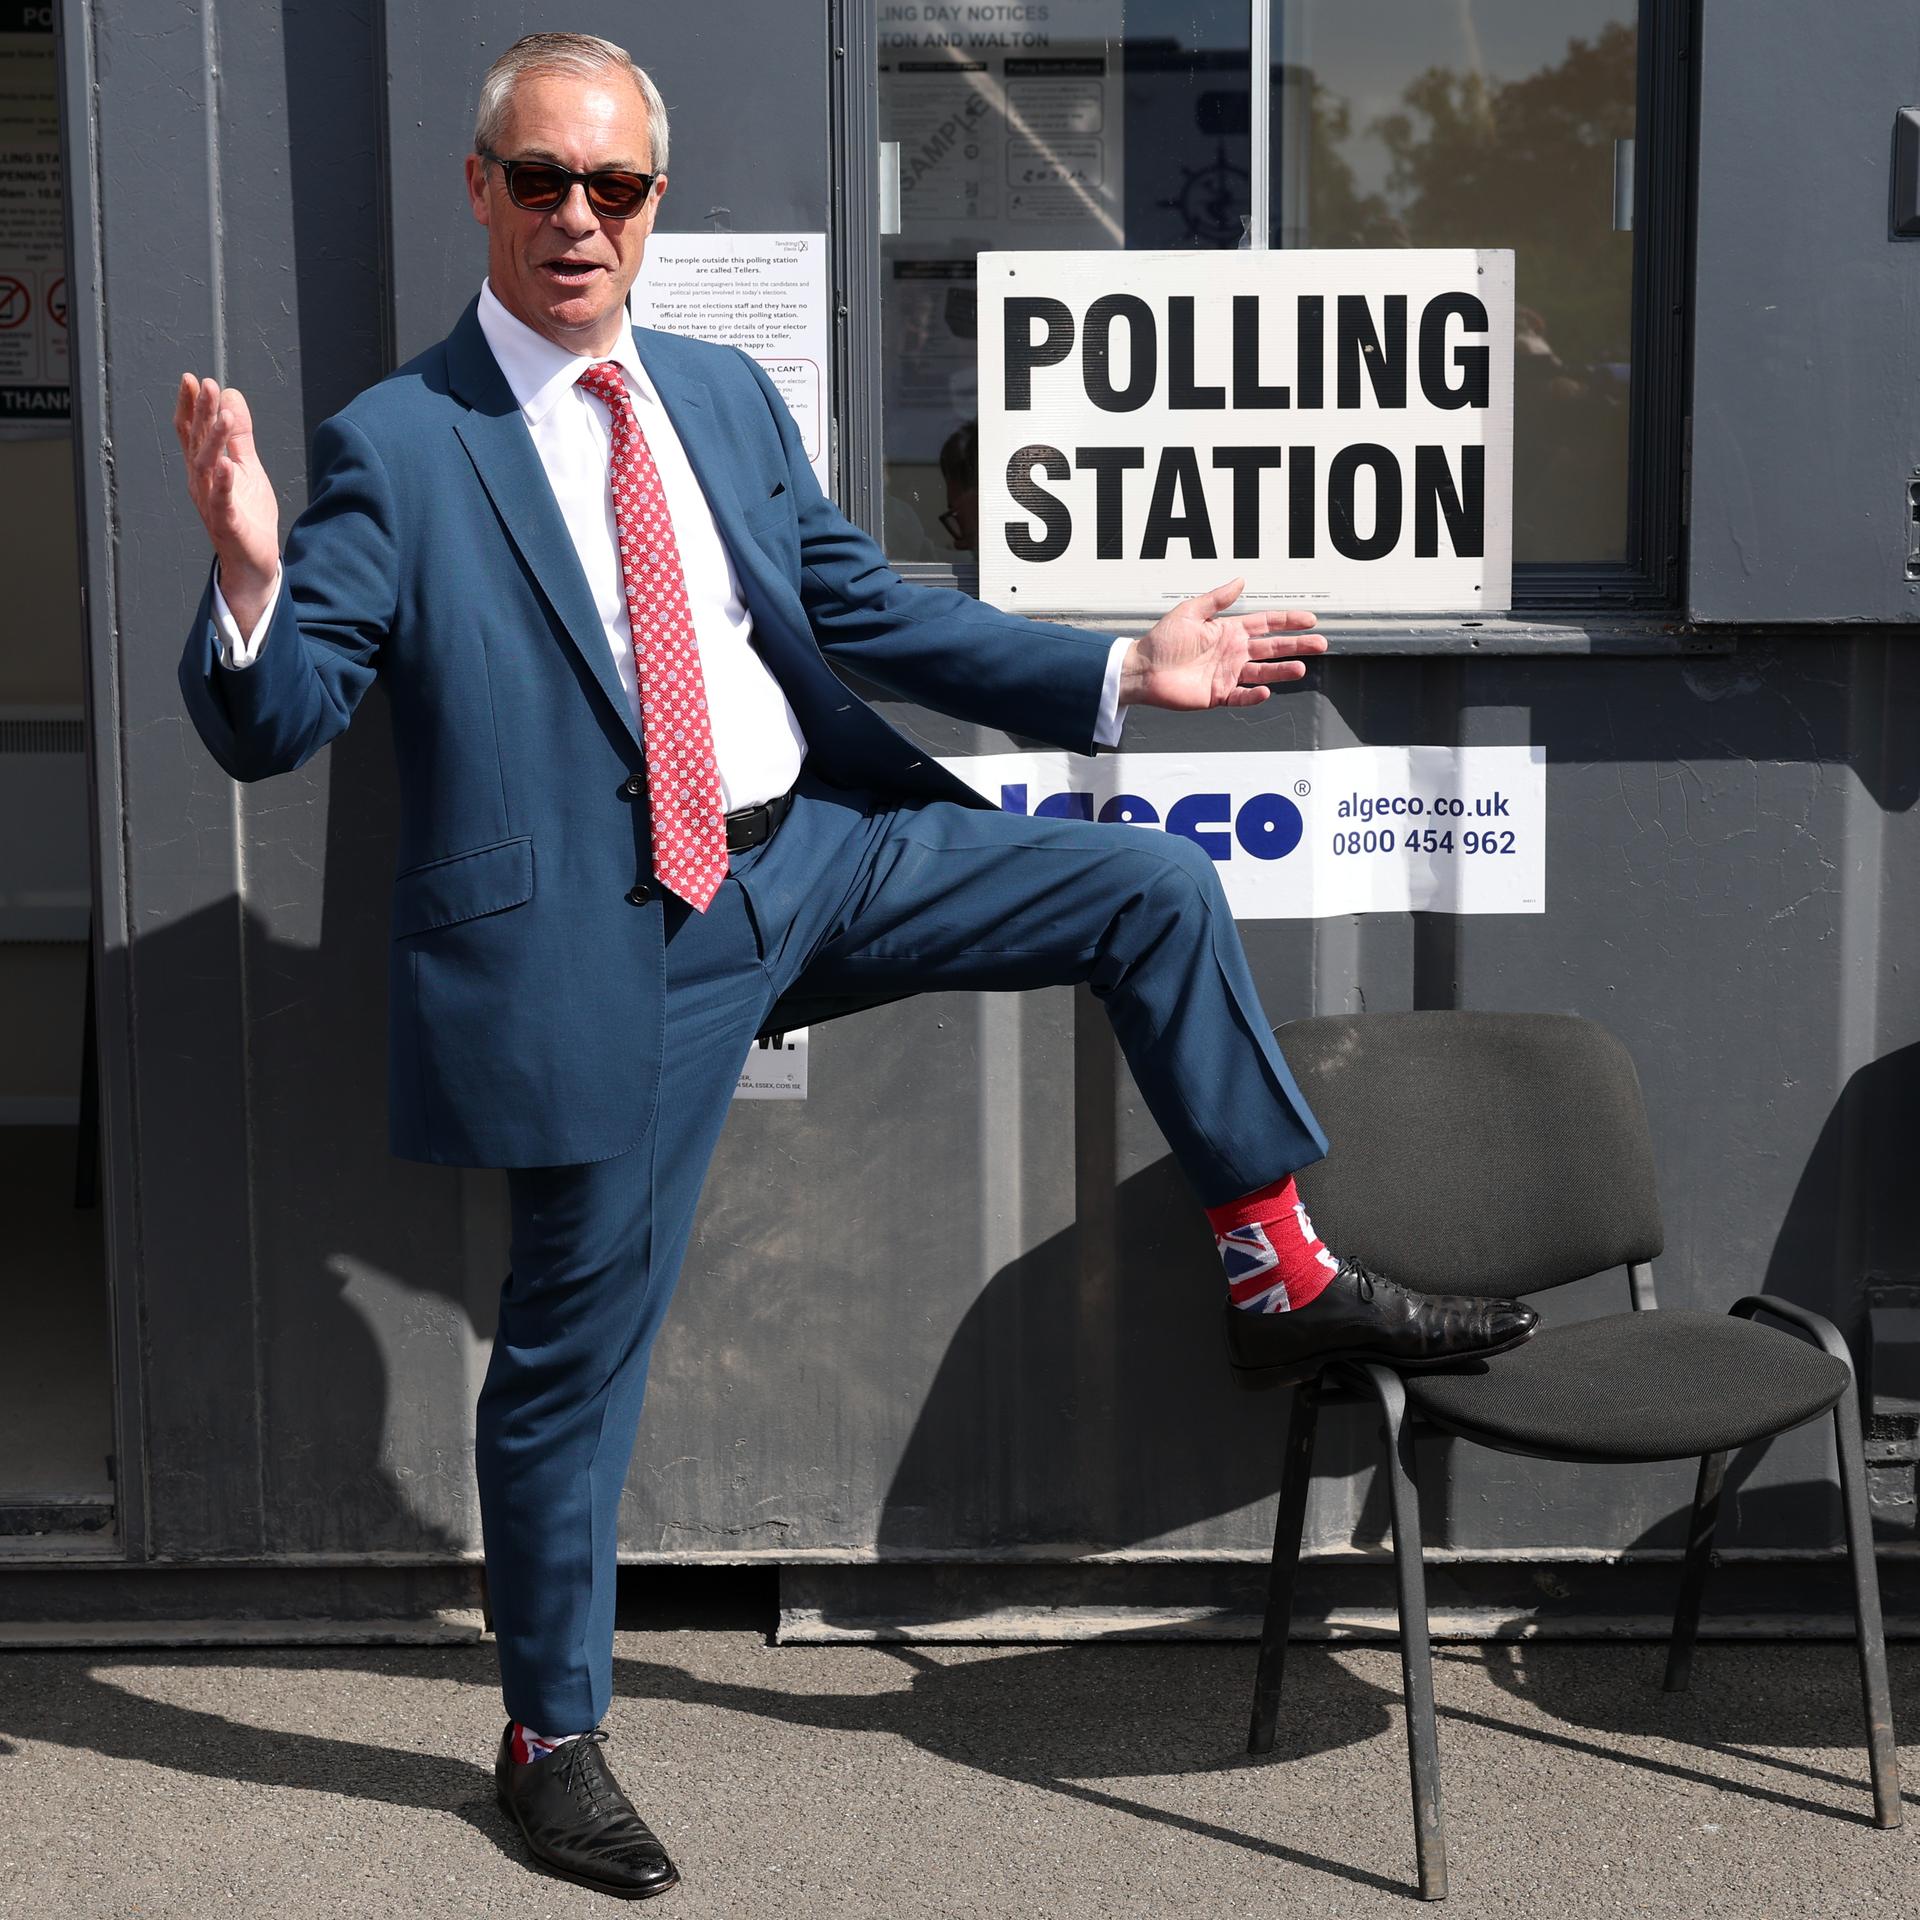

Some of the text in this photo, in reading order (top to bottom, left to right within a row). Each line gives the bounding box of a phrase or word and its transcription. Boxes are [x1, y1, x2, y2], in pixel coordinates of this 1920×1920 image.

[924, 6, 961, 21] DAY
[968, 6, 1049, 21] NOTICES
[924, 33, 962, 48] AND
[968, 33, 1049, 48] WALTON
[901, 92, 990, 192] SAMPLE
[675, 257, 700, 265] people
[746, 257, 771, 265] polling
[1004, 292, 1490, 413] POLLING
[1004, 442, 1485, 563] STATION
[1338, 791, 1510, 822] algeco.co.uk
[1333, 829, 1516, 856] 0800 454 962
